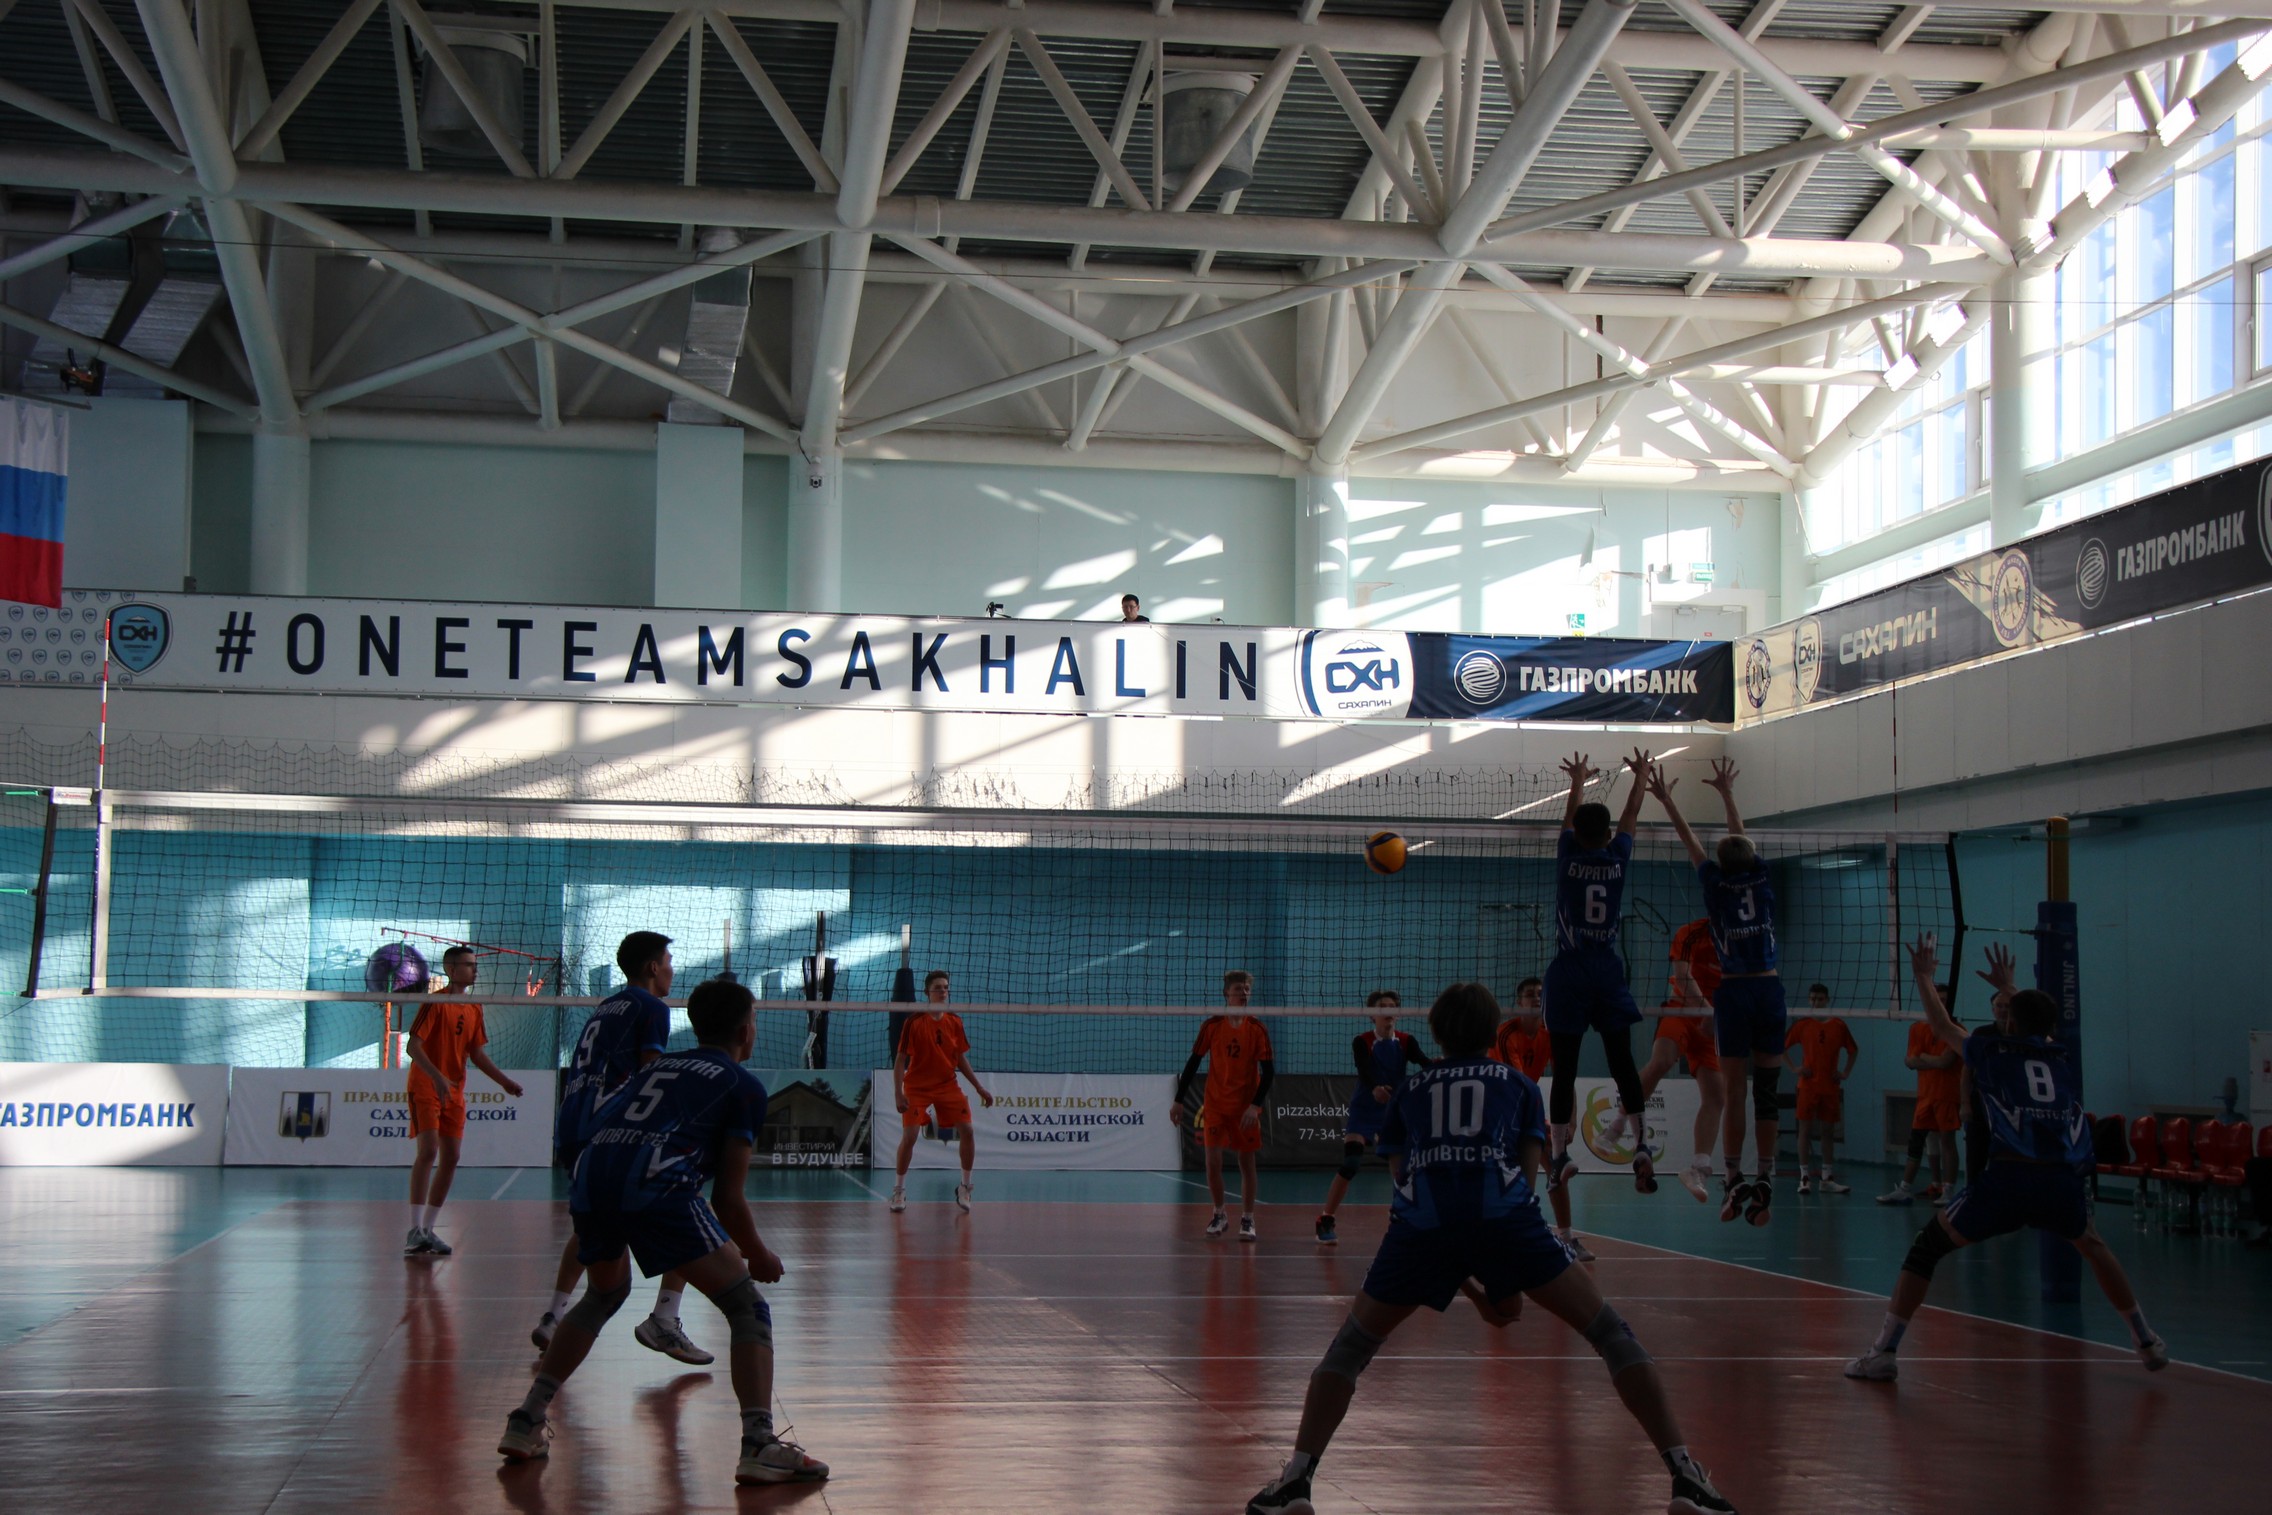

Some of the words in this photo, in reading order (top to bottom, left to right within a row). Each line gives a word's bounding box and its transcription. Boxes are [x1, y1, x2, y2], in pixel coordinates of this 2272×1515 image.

[2117, 510, 2246, 583] ГАЗПРОМБАНК
[1839, 606, 1937, 666] САХАЛИН
[215, 610, 1257, 702] #ONETEAMSAKHALIN
[1519, 665, 1698, 694] ГАЗПРОМБАНК
[1584, 884, 1607, 924] 6
[1737, 886, 1756, 921] 3
[2062, 960, 2076, 1020] JINLING
[455, 1022, 464, 1035] 5
[577, 1019, 601, 1070] 9
[1225, 1044, 1241, 1058] 12
[1409, 1064, 1508, 1092] БУРЯТИЯ
[2024, 1059, 2056, 1103] 8
[344, 1091, 506, 1104] ПРАВИТВО
[624, 1071, 680, 1122] 5
[1428, 1079, 1485, 1138] 10
[0, 1102, 196, 1128] АЗПРОМБАНК
[370, 1106, 517, 1121] САХСКОЙ
[1006, 1111, 1145, 1126] САХАЛИНСКОЙ
[773, 1141, 836, 1151] ИНВЕСТИРУЙ
[1007, 1130, 1090, 1143] ОБЛАСТИ
[772, 1153, 782, 1165] В
[787, 1153, 864, 1167] БУДУЩЕЕ
